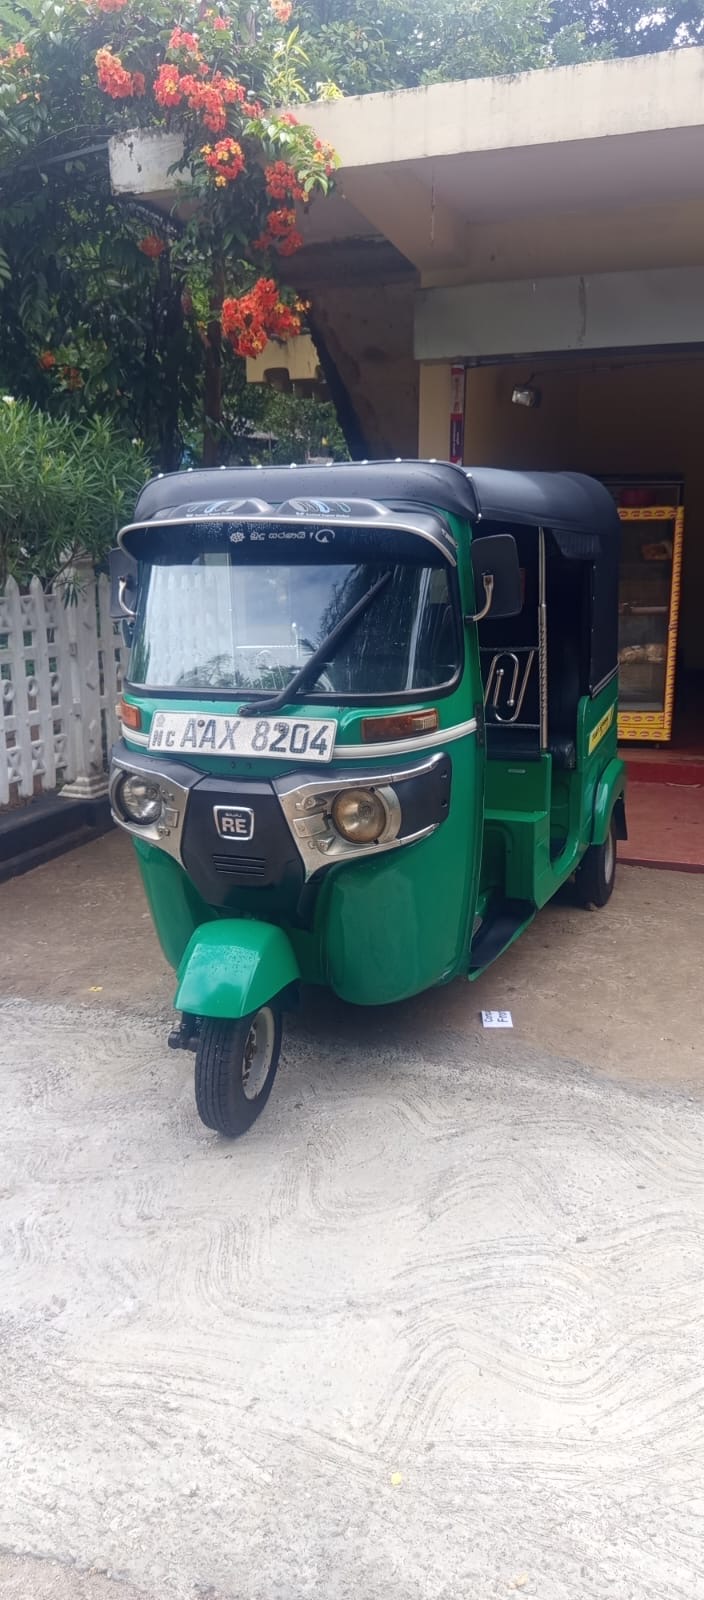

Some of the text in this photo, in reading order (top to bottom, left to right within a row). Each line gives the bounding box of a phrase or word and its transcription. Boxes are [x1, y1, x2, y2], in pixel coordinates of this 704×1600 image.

[180, 719, 329, 755] AAX 8204
[221, 817, 248, 834] RE
